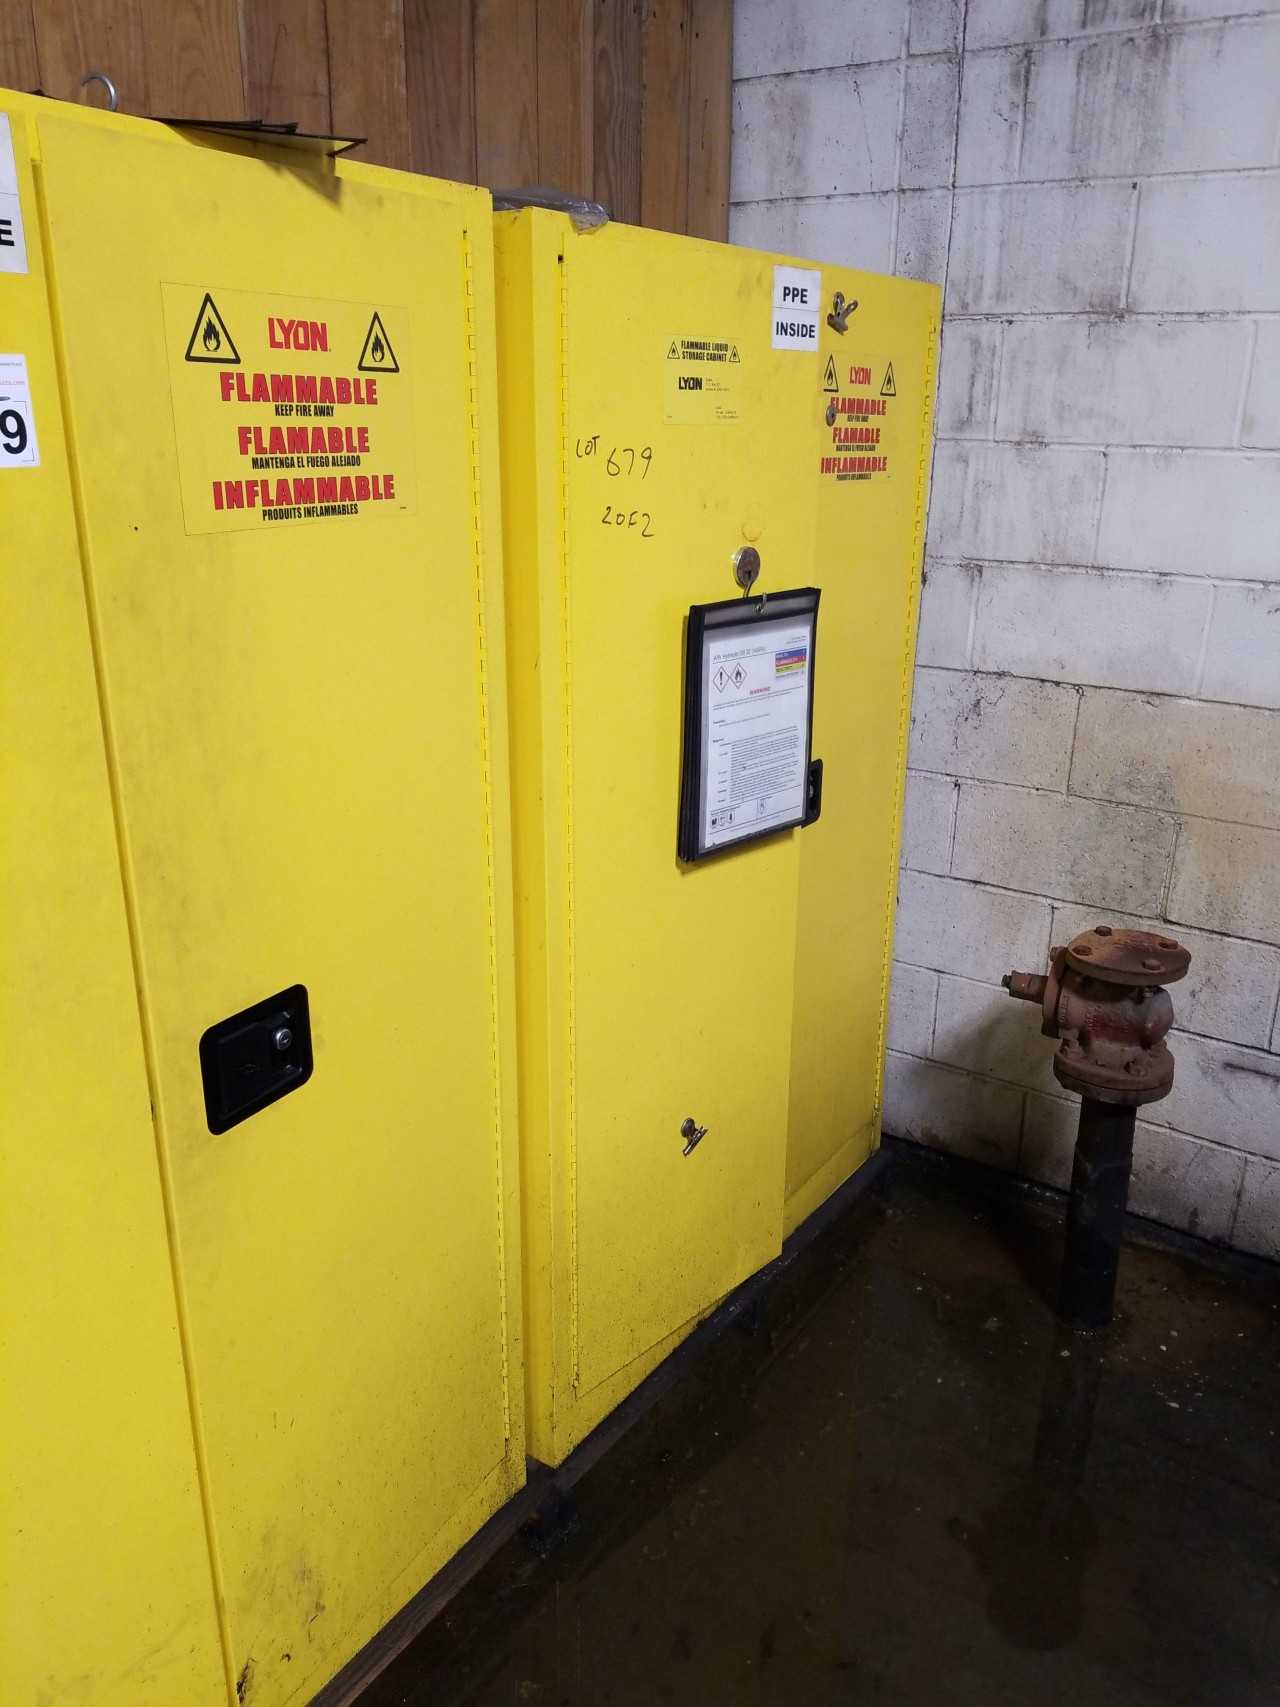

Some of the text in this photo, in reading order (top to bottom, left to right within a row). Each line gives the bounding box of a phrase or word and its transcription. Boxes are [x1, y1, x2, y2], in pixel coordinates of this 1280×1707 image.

[783, 286, 808, 304] PPE
[268, 317, 328, 352] LYON
[776, 321, 816, 338] INSIDE
[681, 340, 711, 351] FLAMMABLE
[678, 376, 702, 390] LYON
[849, 366, 871, 385] LYON
[219, 371, 378, 405] FLAMMABLE
[275, 404, 335, 417] KEEP FIRE AWAY
[237, 426, 370, 455] FLAMABLE
[252, 455, 361, 469] MANTENGA EL FUEGO ALEJADO
[576, 435, 652, 480] LOT 679
[212, 474, 396, 511] INFLAMMABLE
[262, 503, 359, 521] PRODUITS INFLAMMABLES
